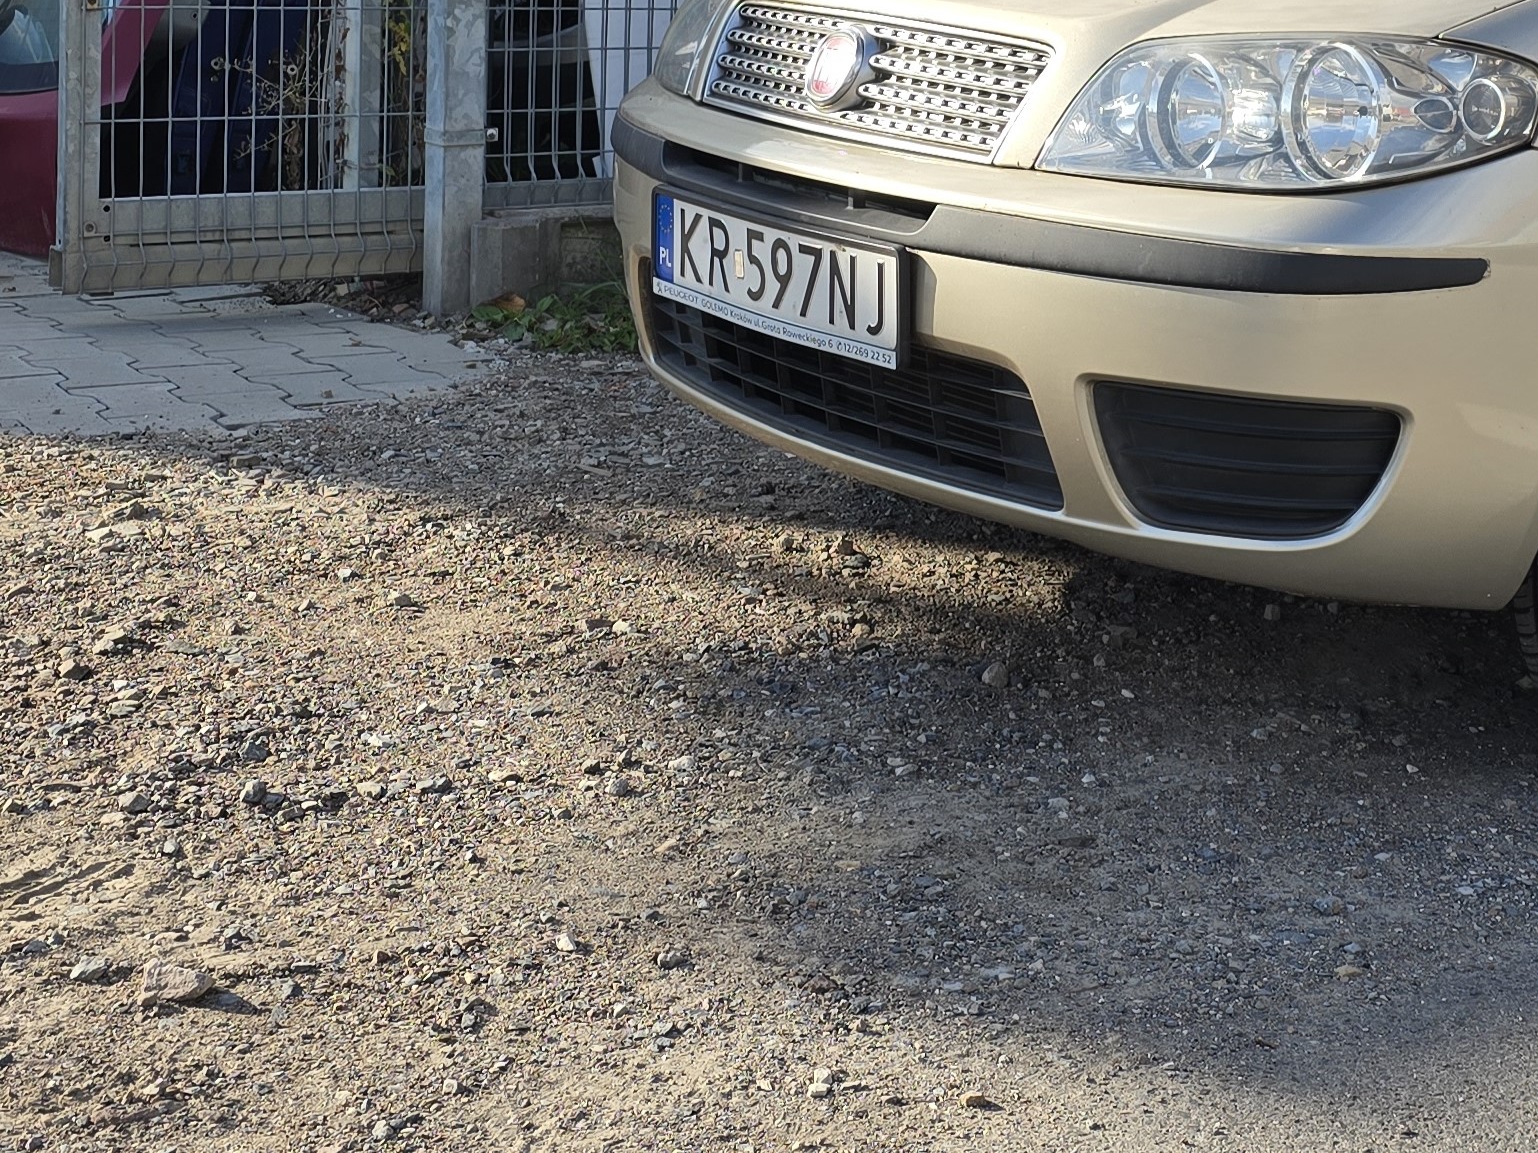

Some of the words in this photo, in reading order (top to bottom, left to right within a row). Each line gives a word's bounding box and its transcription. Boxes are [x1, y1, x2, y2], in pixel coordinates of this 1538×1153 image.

[659, 246, 672, 268] PL
[680, 208, 730, 294] KR
[746, 227, 886, 336] 597NJ
[870, 352, 881, 361] 22
[882, 353, 892, 365] 52
